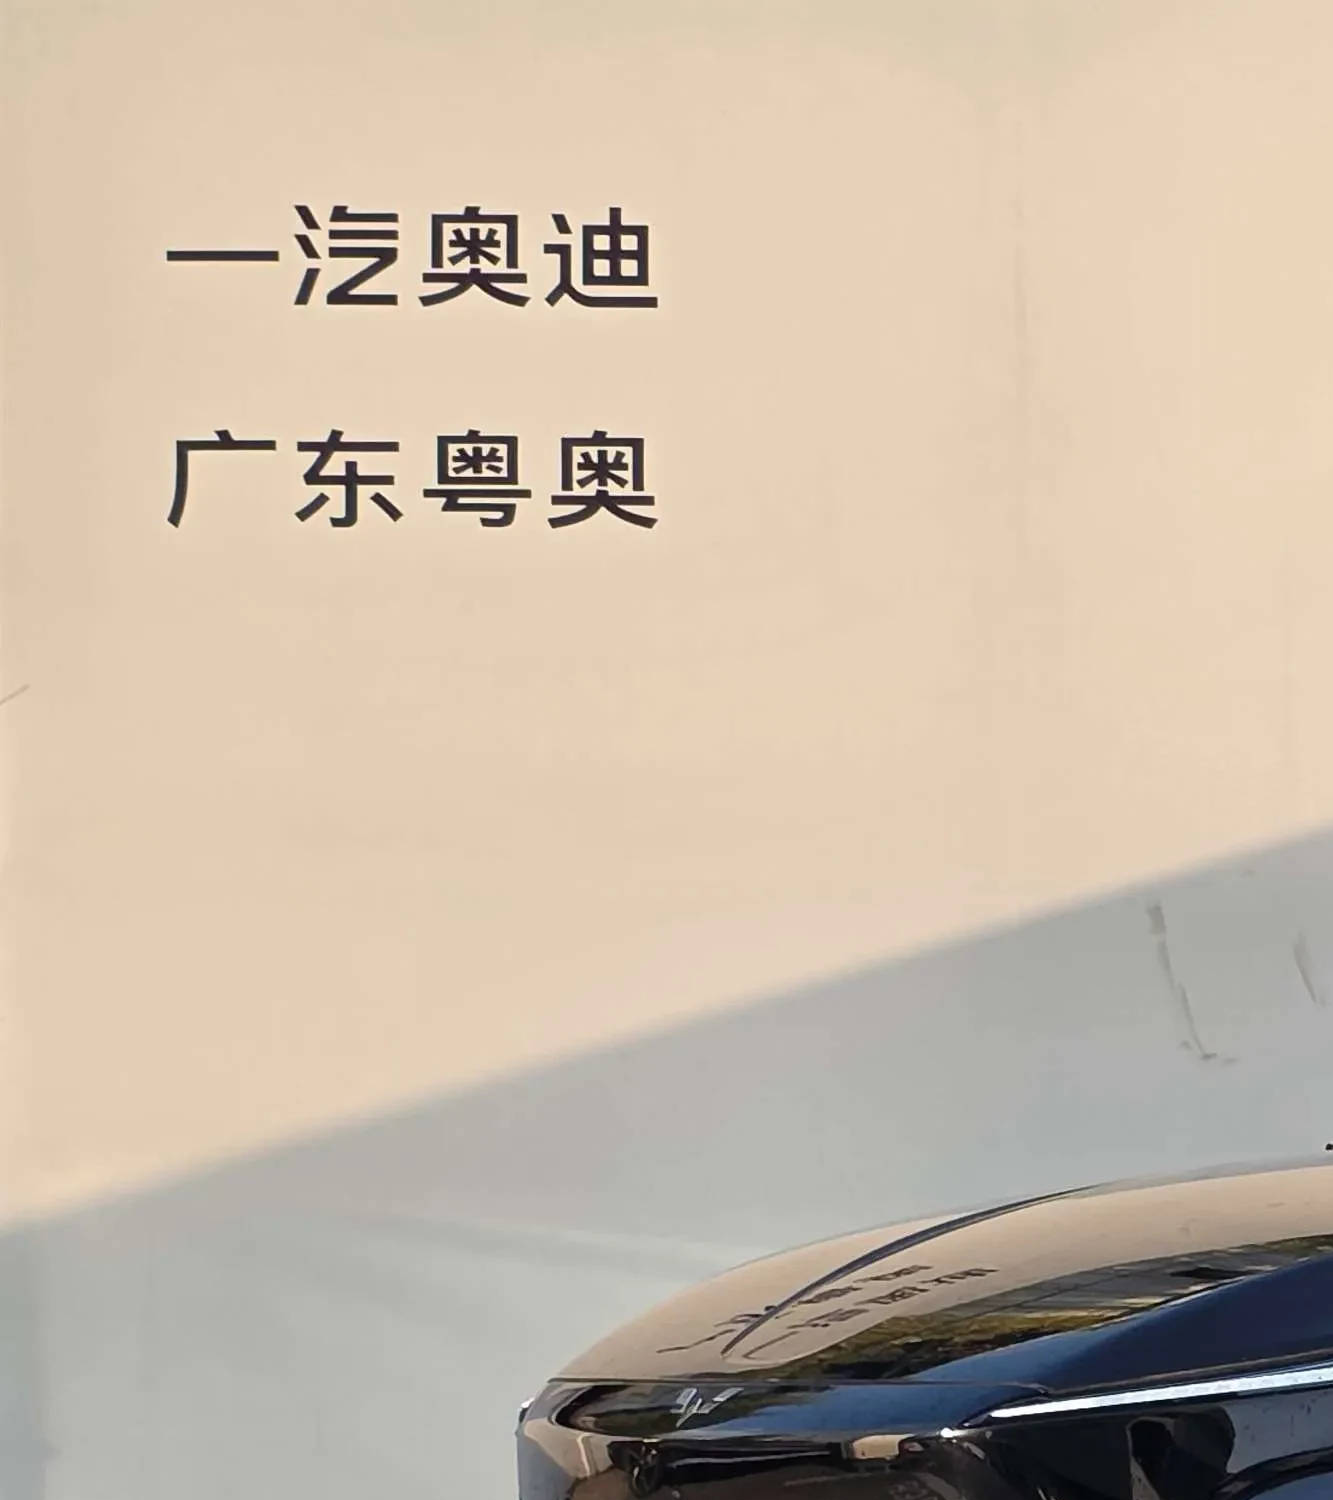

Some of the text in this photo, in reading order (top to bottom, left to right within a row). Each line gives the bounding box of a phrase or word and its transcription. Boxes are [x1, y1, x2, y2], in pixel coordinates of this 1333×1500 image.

[166, 204, 659, 309] 一汽奥迪
[167, 429, 659, 529] 广东粤奥
